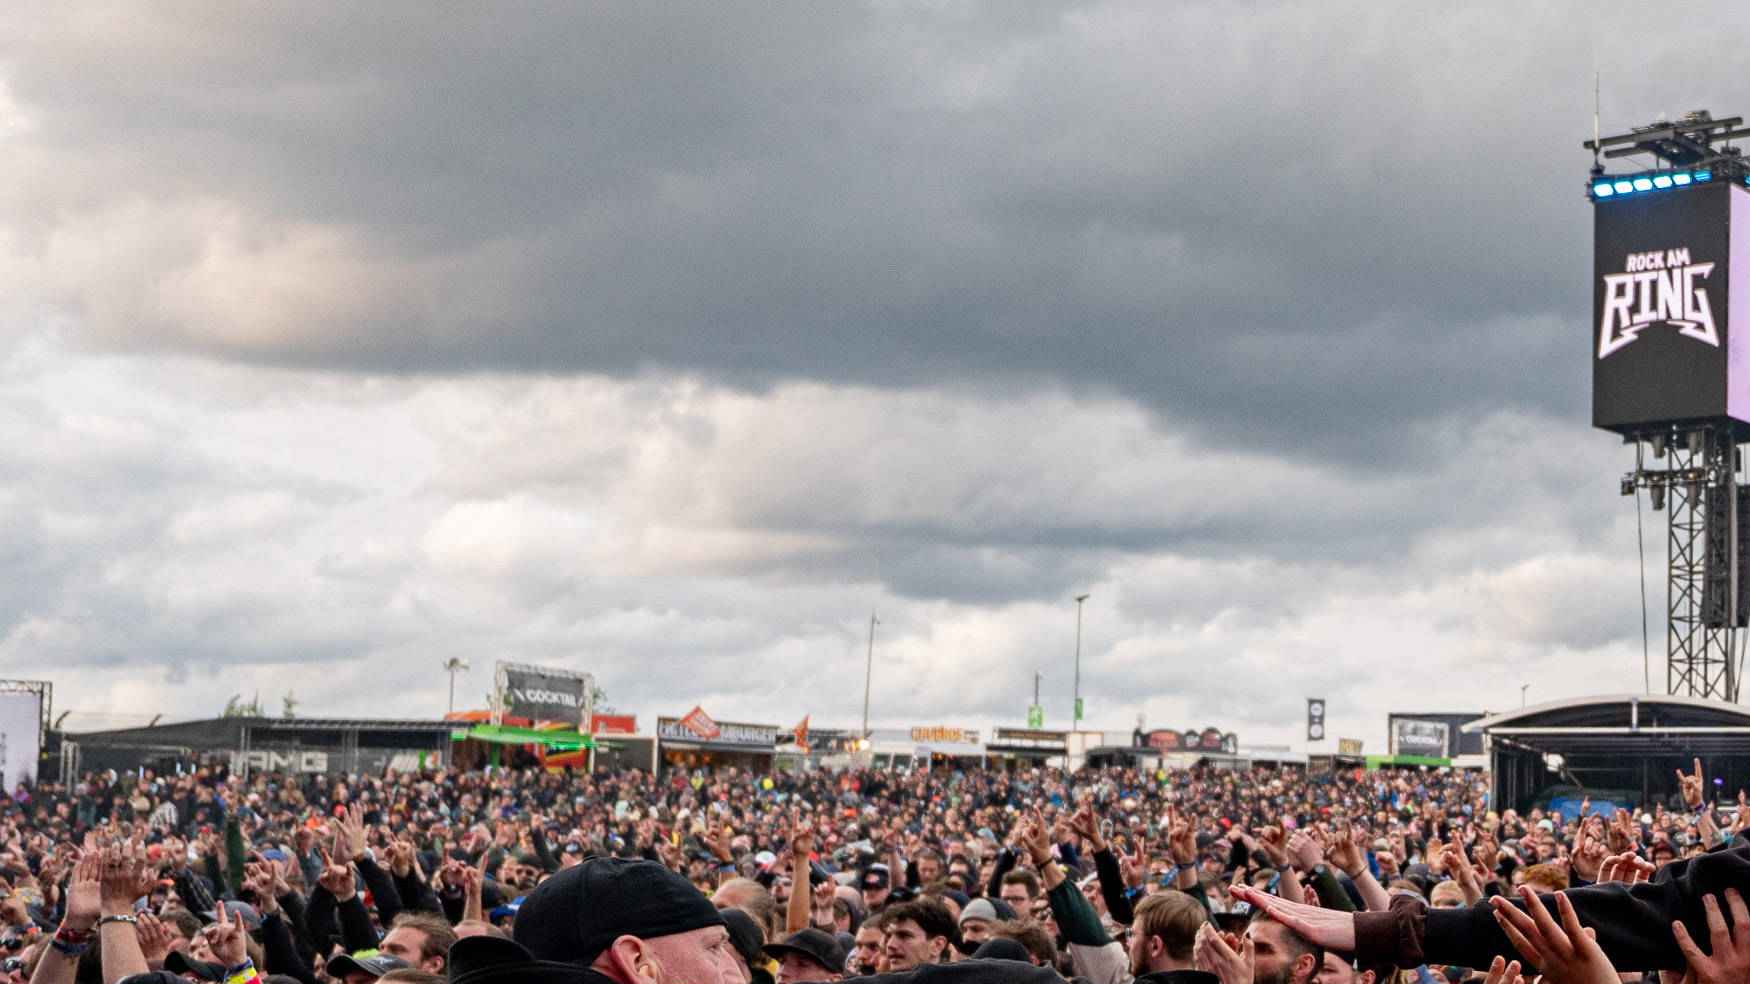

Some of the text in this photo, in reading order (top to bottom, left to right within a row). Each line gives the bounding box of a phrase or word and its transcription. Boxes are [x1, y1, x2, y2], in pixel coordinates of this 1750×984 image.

[1626, 247, 1691, 272] ROCK AM
[1598, 262, 1719, 359] RING
